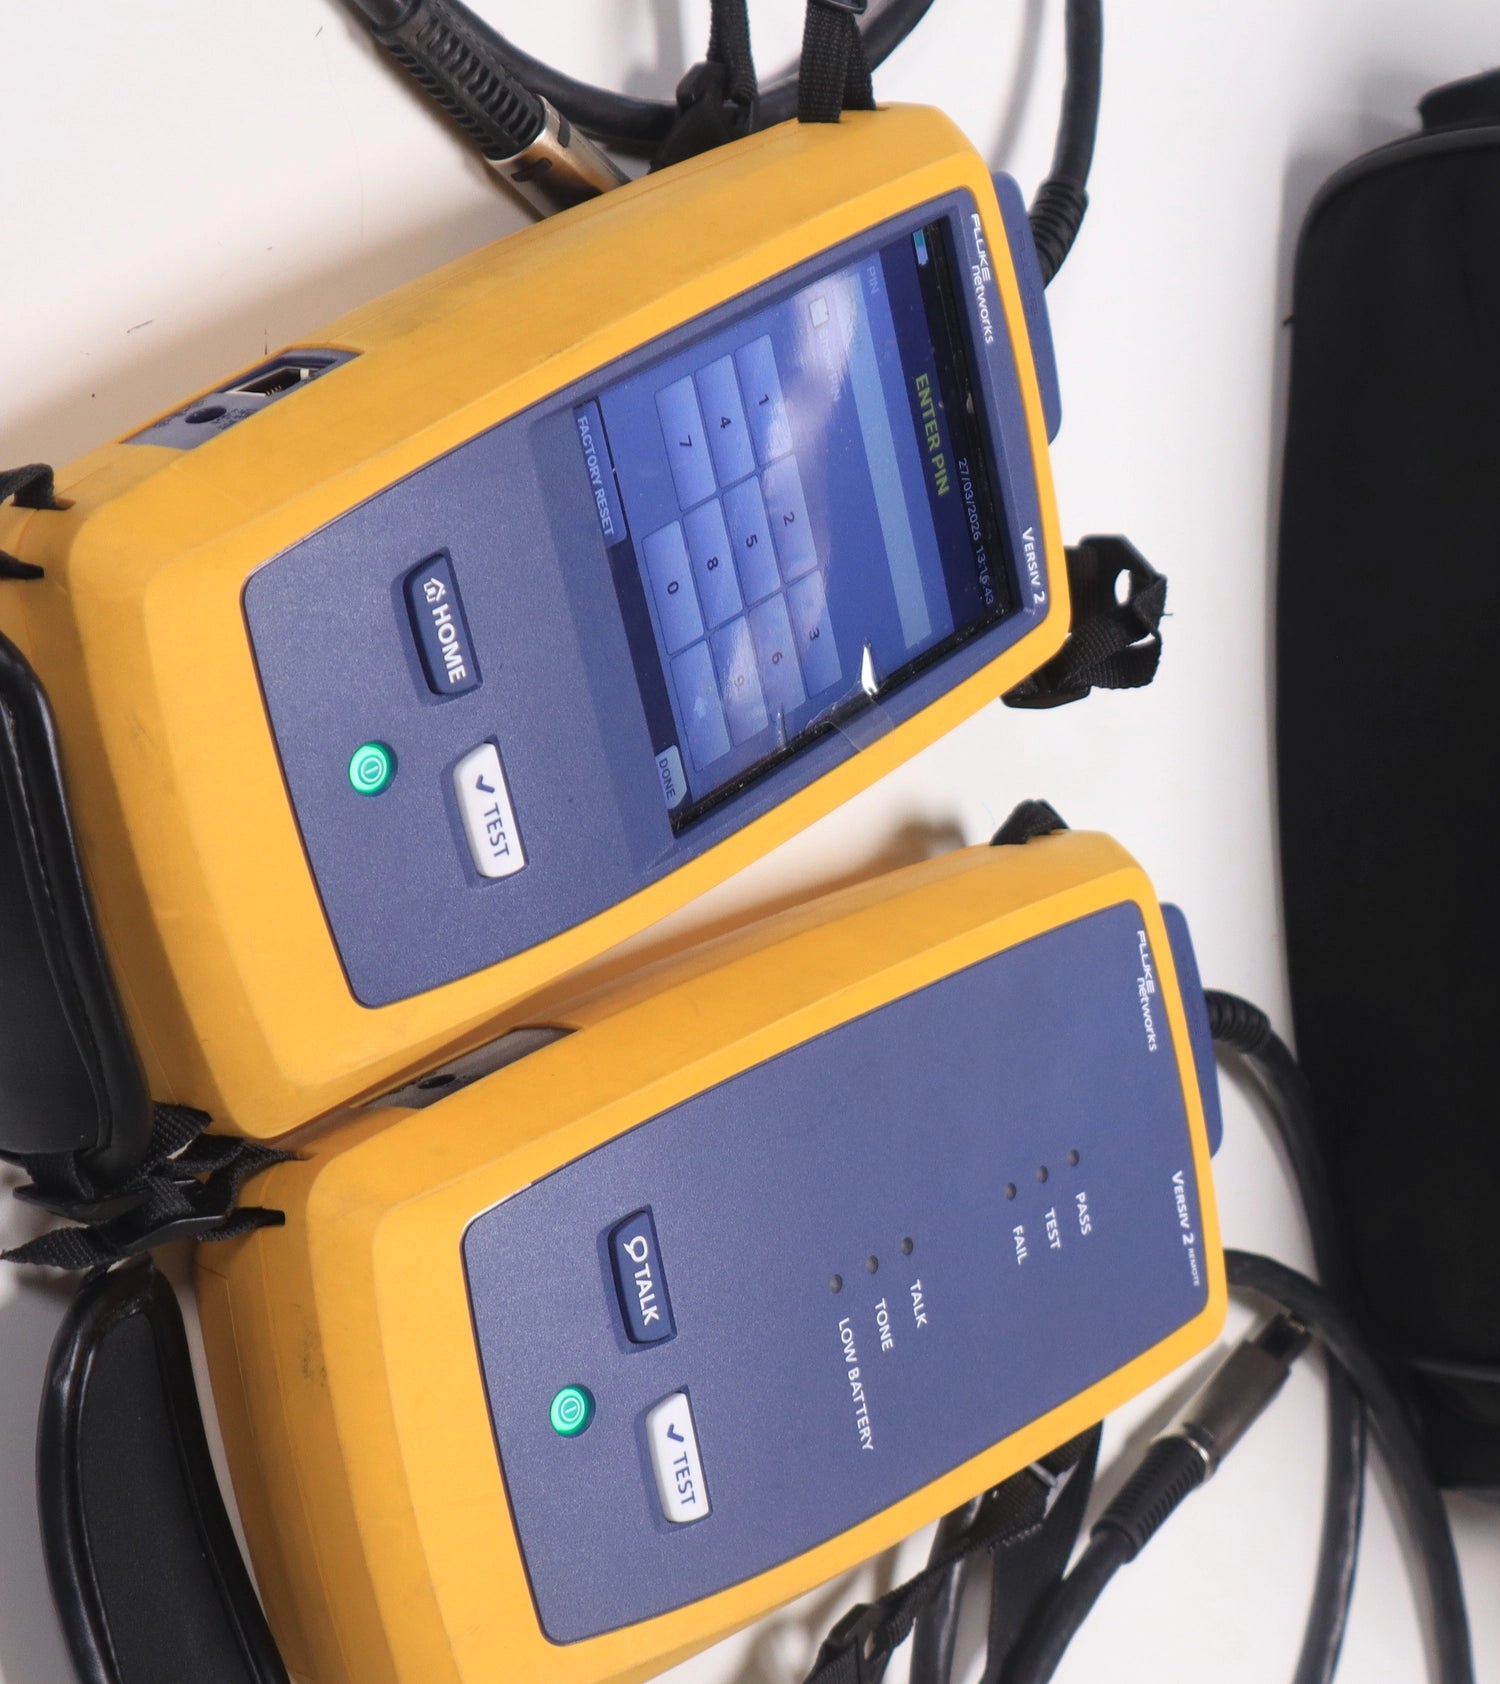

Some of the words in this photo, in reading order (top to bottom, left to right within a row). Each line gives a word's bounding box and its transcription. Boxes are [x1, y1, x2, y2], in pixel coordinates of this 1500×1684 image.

[971, 212, 992, 282] FLUKE
[866, 265, 880, 295] PIN
[972, 264, 995, 345] networks
[758, 394, 770, 406] 1
[829, 373, 841, 402] PIN
[679, 434, 692, 448] 7
[719, 415, 732, 430] 4
[915, 372, 941, 452] ENTER
[930, 453, 950, 497] PIN
[576, 415, 602, 486] FACTORY
[593, 487, 615, 536] RESET
[745, 534, 758, 548] 5
[783, 512, 797, 528] 2
[957, 456, 980, 542] 27/03/2026
[976, 545, 994, 606] 13:16:43
[706, 557, 720, 571] 8
[666, 581, 680, 596] 0
[1033, 590, 1046, 605] 2
[432, 604, 466, 684] HOME
[808, 627, 821, 641] 3
[770, 650, 783, 665] 6
[733, 674, 746, 688] 9
[658, 757, 676, 799] DONE
[484, 802, 510, 857] TEST
[1137, 930, 1156, 994] FLUKE
[1136, 976, 1157, 1052] networks
[1044, 1207, 1061, 1250] TEST
[1075, 1191, 1093, 1235] PASS
[1012, 1224, 1028, 1265] FAIL
[1182, 1233, 1195, 1245] 2
[1188, 1248, 1200, 1287] REMOTE
[634, 1263, 660, 1326] TALK
[910, 1279, 928, 1329] TALK
[875, 1298, 894, 1352] TONE
[839, 1318, 857, 1364] LOW
[848, 1366, 875, 1451] BATTERY
[673, 1451, 696, 1505] TEST
